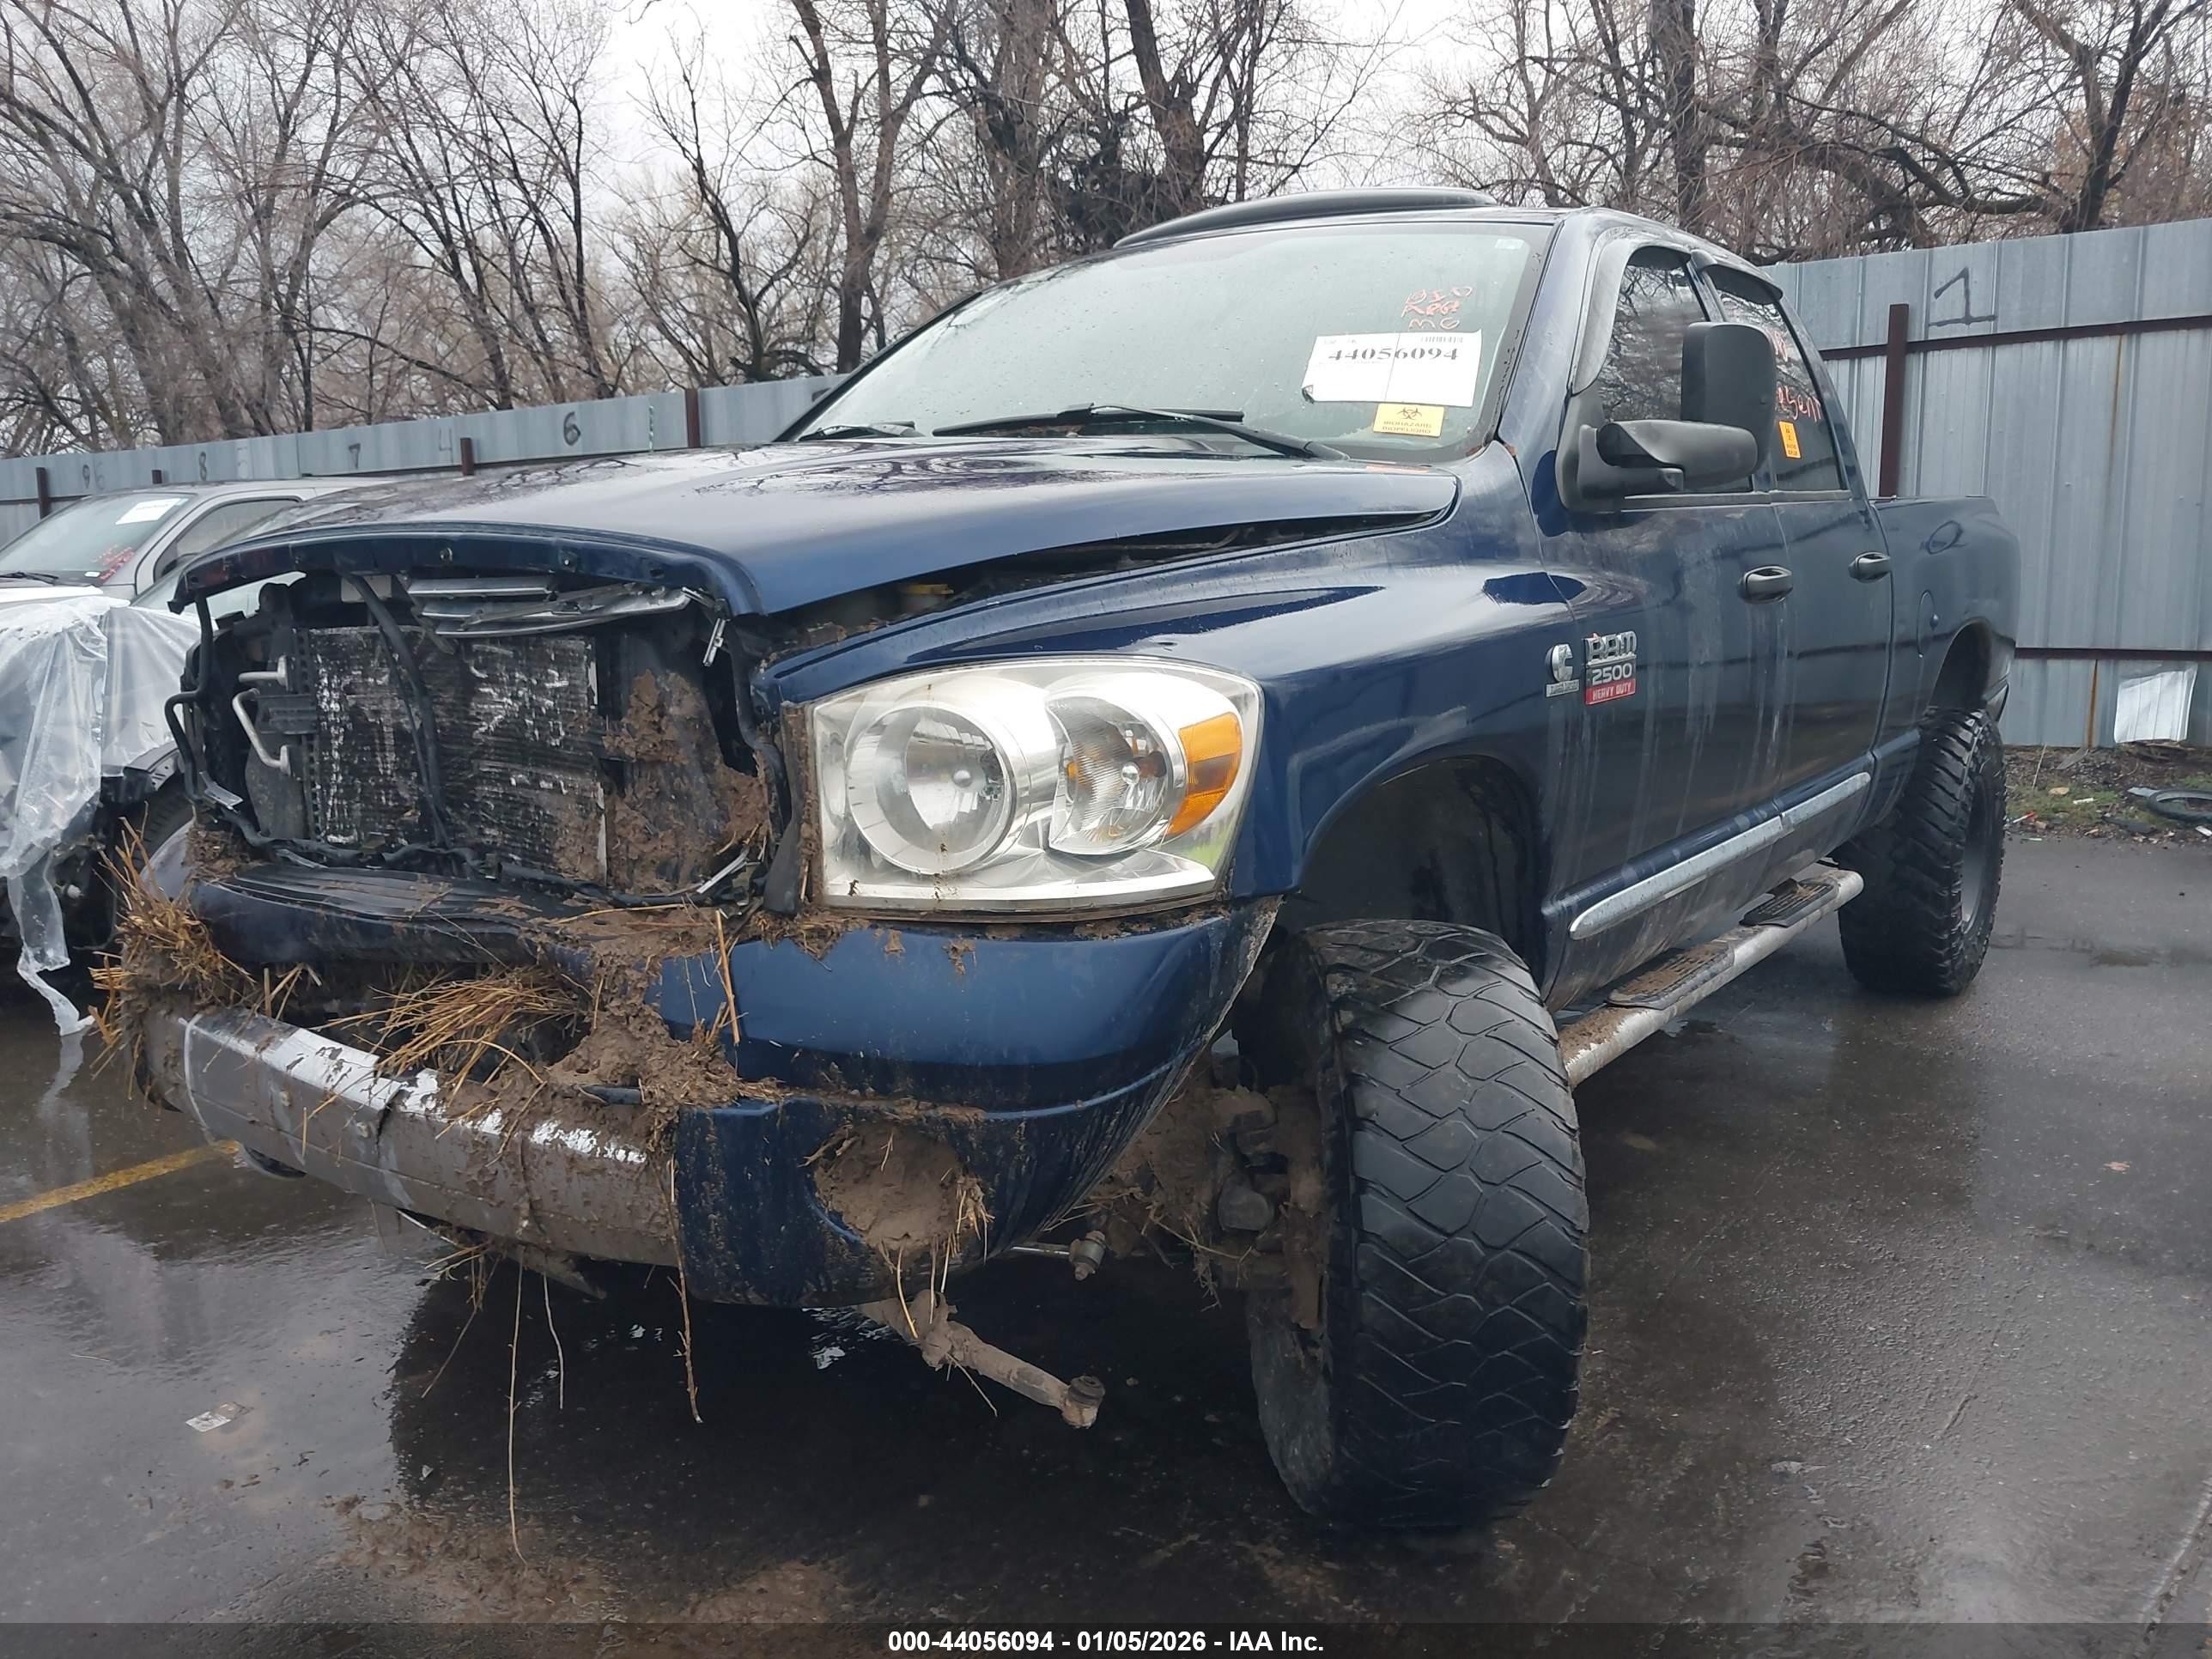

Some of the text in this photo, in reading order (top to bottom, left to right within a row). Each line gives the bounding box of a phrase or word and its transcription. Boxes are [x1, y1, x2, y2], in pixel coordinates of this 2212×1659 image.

[1929, 267, 1997, 325] 1
[1328, 347, 1458, 361] 44056094
[562, 411, 581, 446] 6
[82, 464, 91, 489] 9
[198, 452, 208, 482] 8
[1591, 662, 1632, 686] 2500
[1592, 686, 1615, 702] HEAVY
[1615, 682, 1632, 696] DUTY
